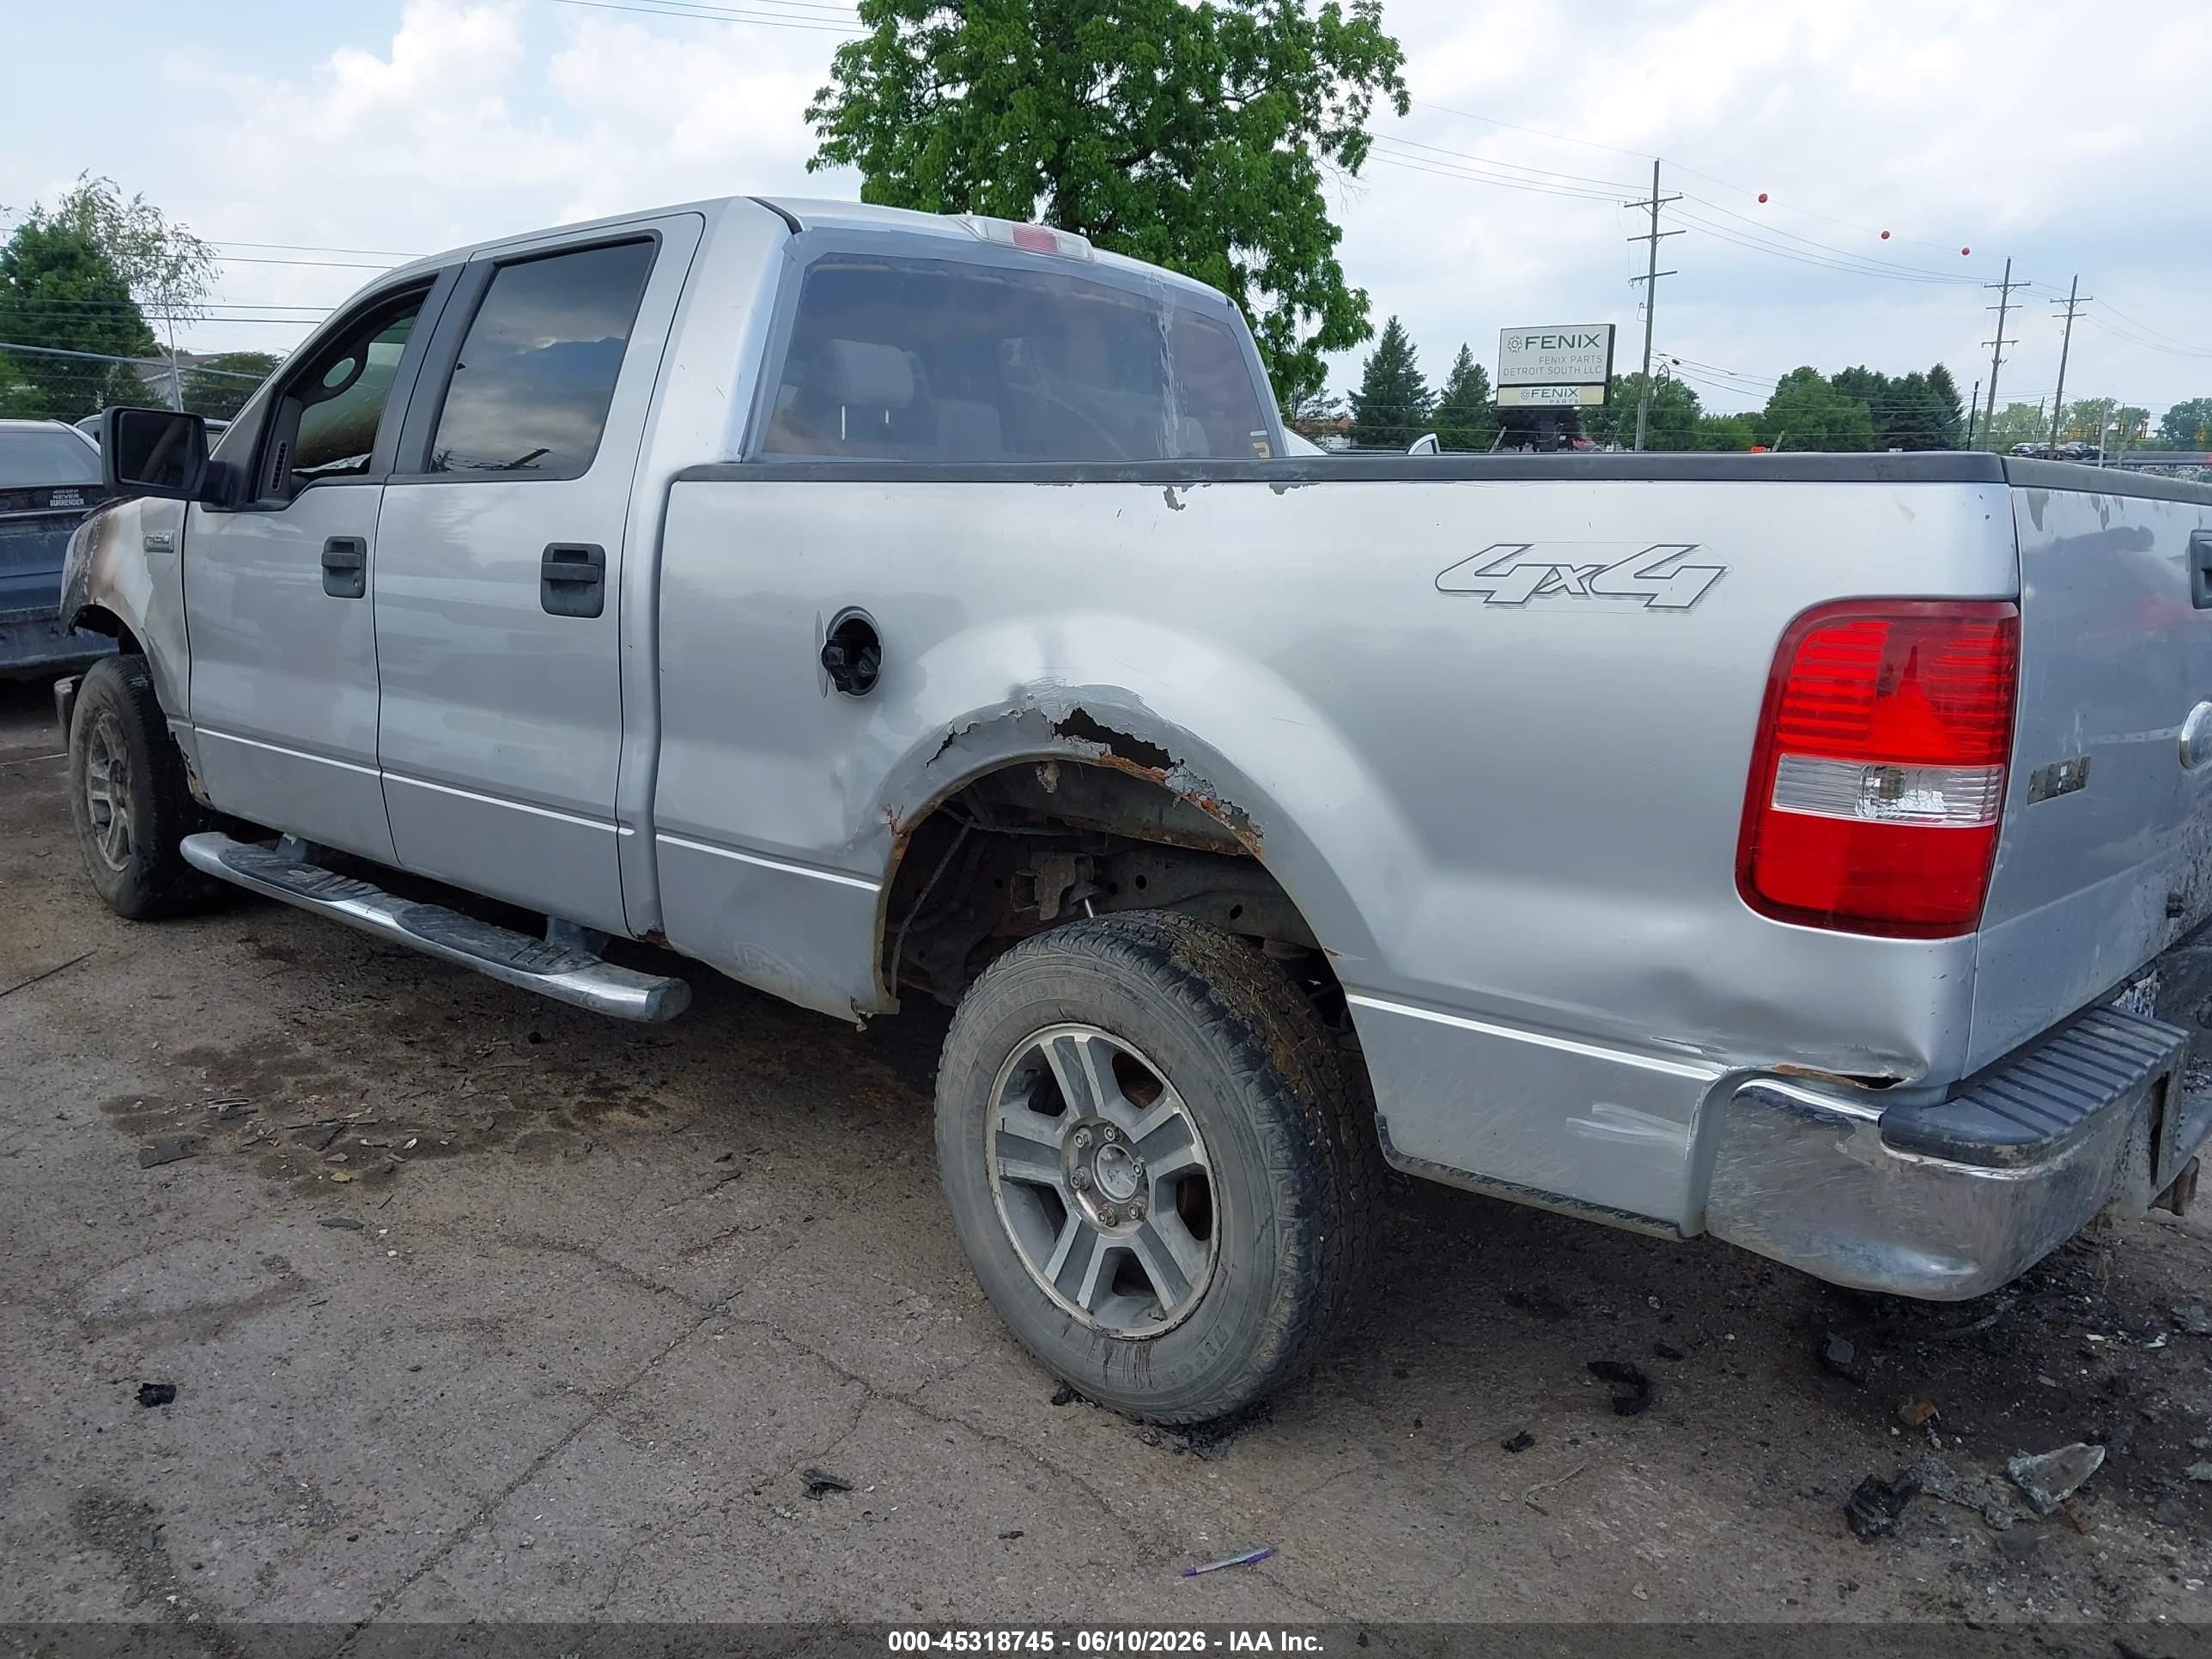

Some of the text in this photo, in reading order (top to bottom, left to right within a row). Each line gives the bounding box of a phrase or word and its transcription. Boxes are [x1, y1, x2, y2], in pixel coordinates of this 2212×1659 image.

[1525, 334, 1601, 350] FENIX
[1539, 355, 1602, 365] FENIX PARTS
[1504, 365, 1601, 376] DETROIT SOUTH LLC
[1531, 387, 1579, 398] FENIX
